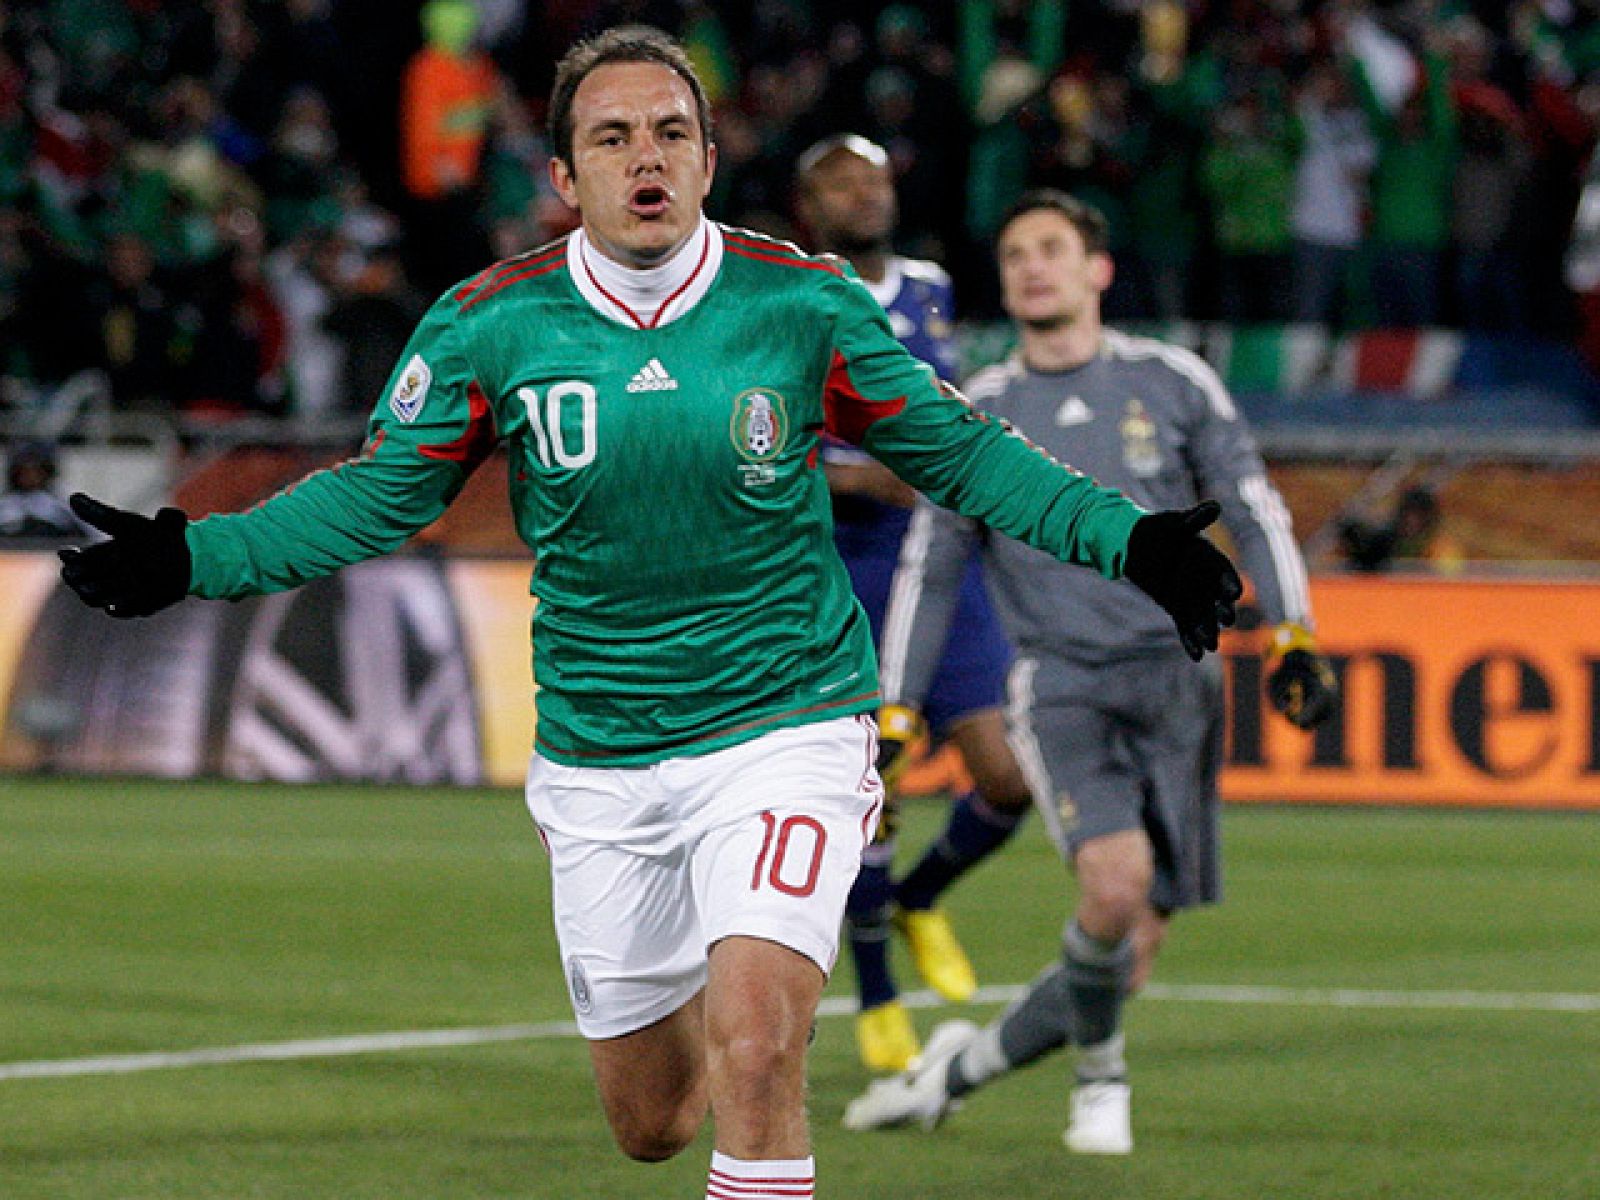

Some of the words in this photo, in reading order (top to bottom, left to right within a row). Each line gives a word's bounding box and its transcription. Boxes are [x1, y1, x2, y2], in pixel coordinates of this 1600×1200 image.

[518, 381, 597, 468] 10
[1223, 606, 1600, 780] ine
[751, 810, 828, 897] 10
